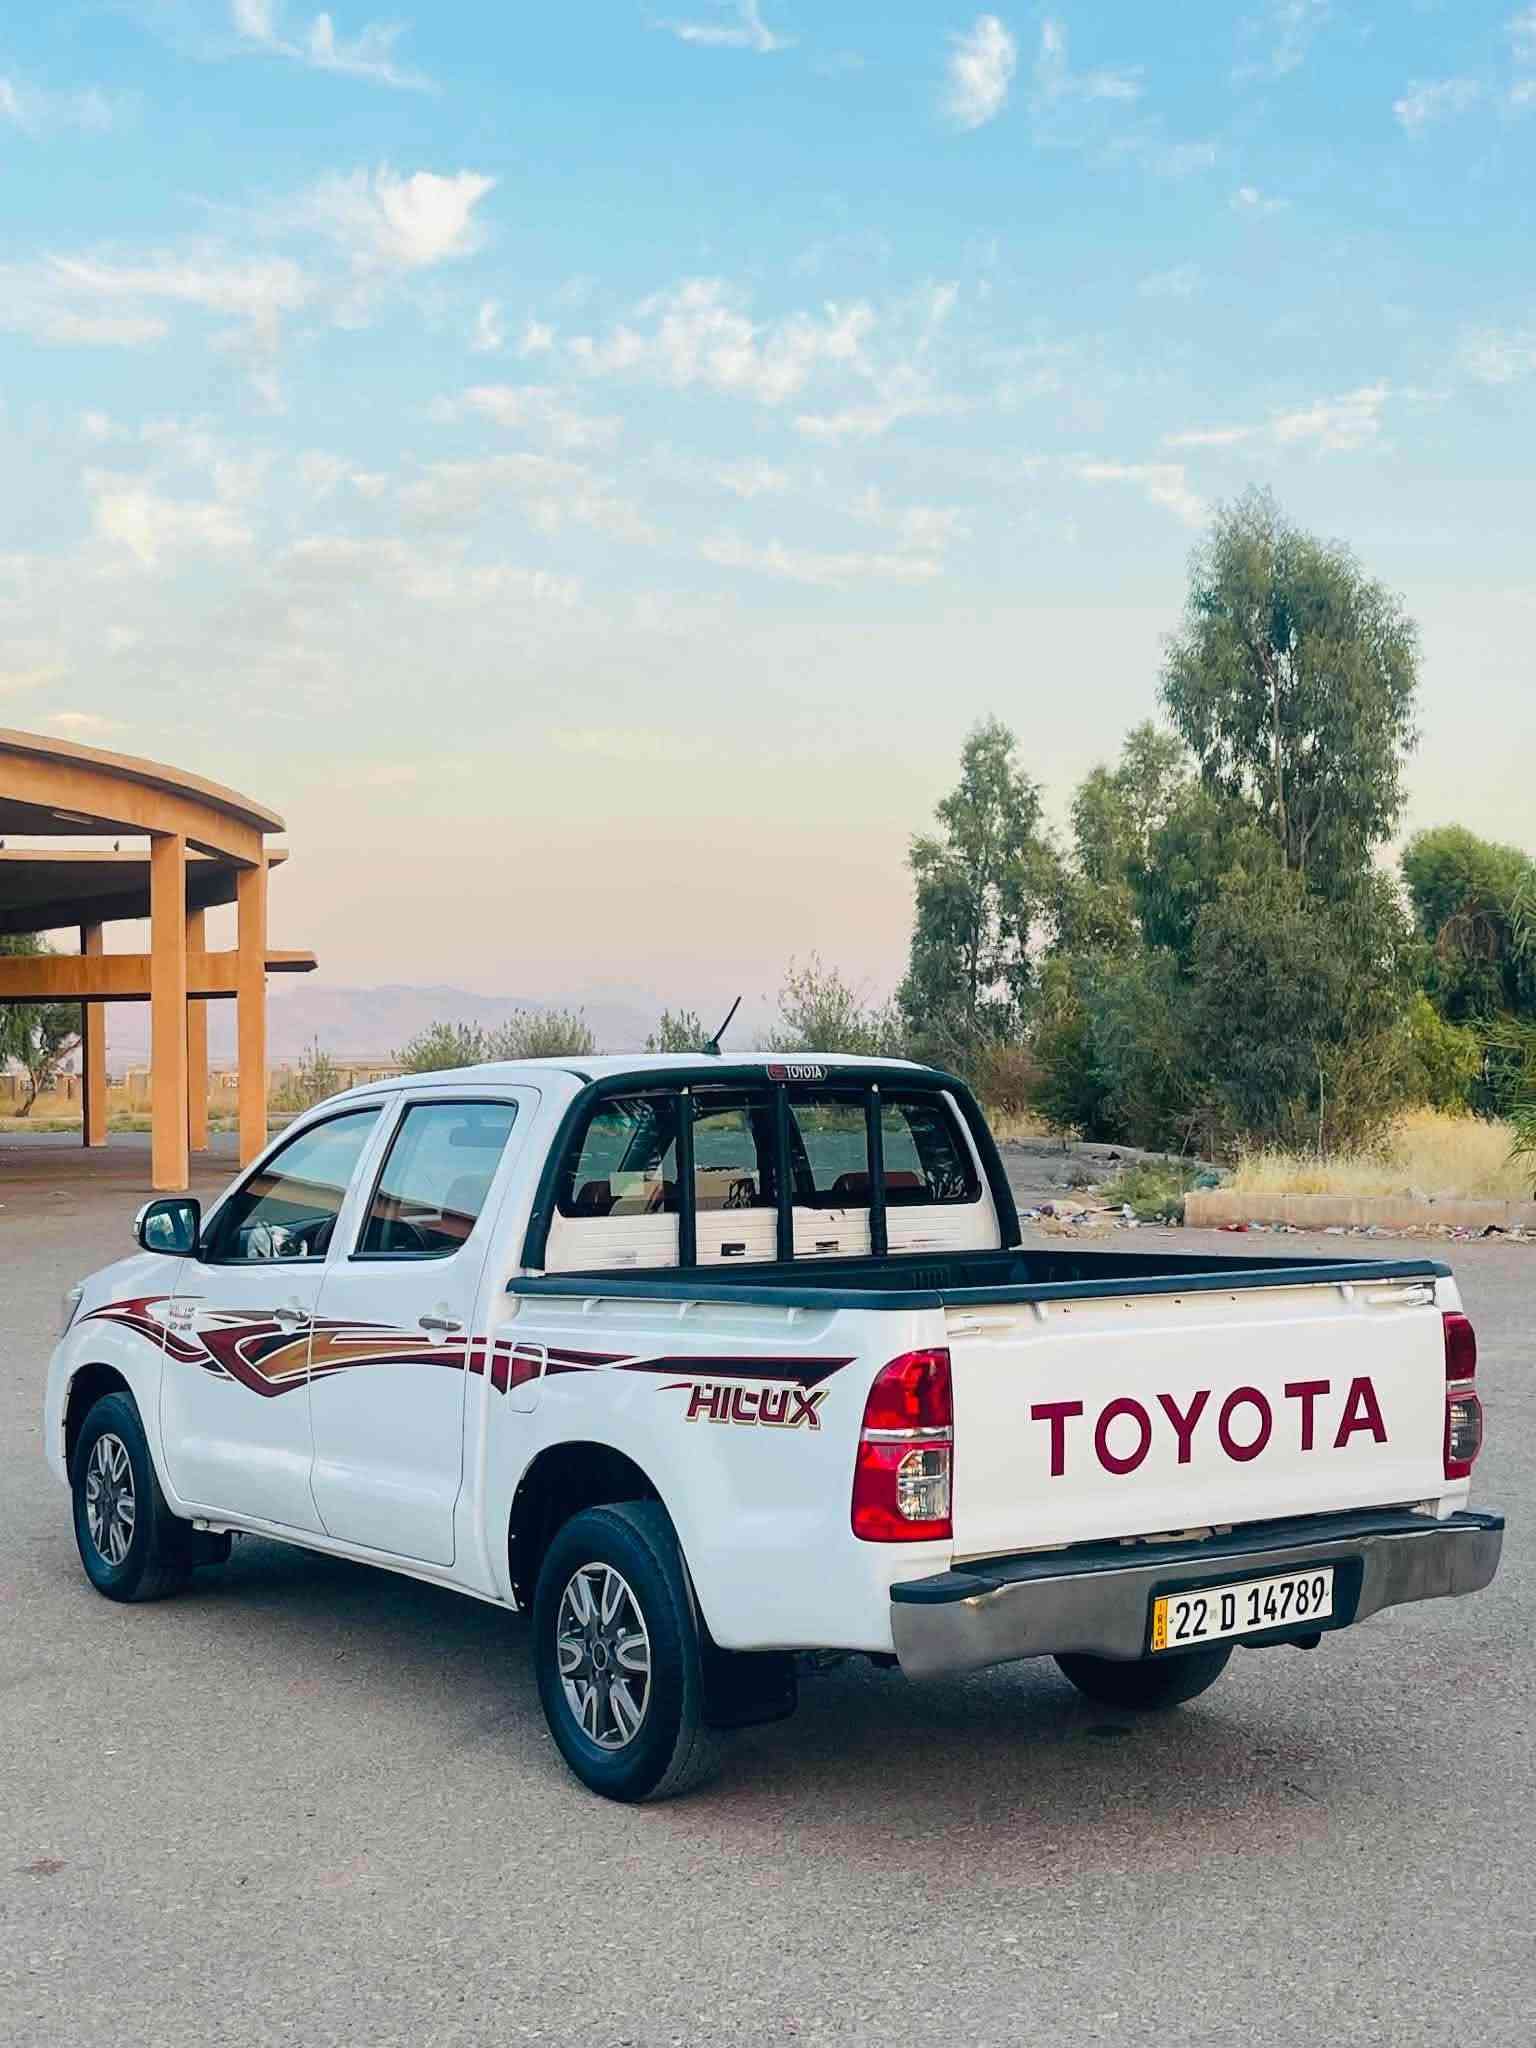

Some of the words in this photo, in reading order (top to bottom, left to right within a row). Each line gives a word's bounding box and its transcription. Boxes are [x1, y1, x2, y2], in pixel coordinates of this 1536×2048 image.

[785, 1065, 822, 1078] TOYOTA
[687, 1384, 826, 1427] HILUX
[1030, 1376, 1388, 1477] TOYOTA
[1175, 1599, 1207, 1640] 22
[1220, 1593, 1235, 1631] D
[1247, 1576, 1325, 1626] 14789
